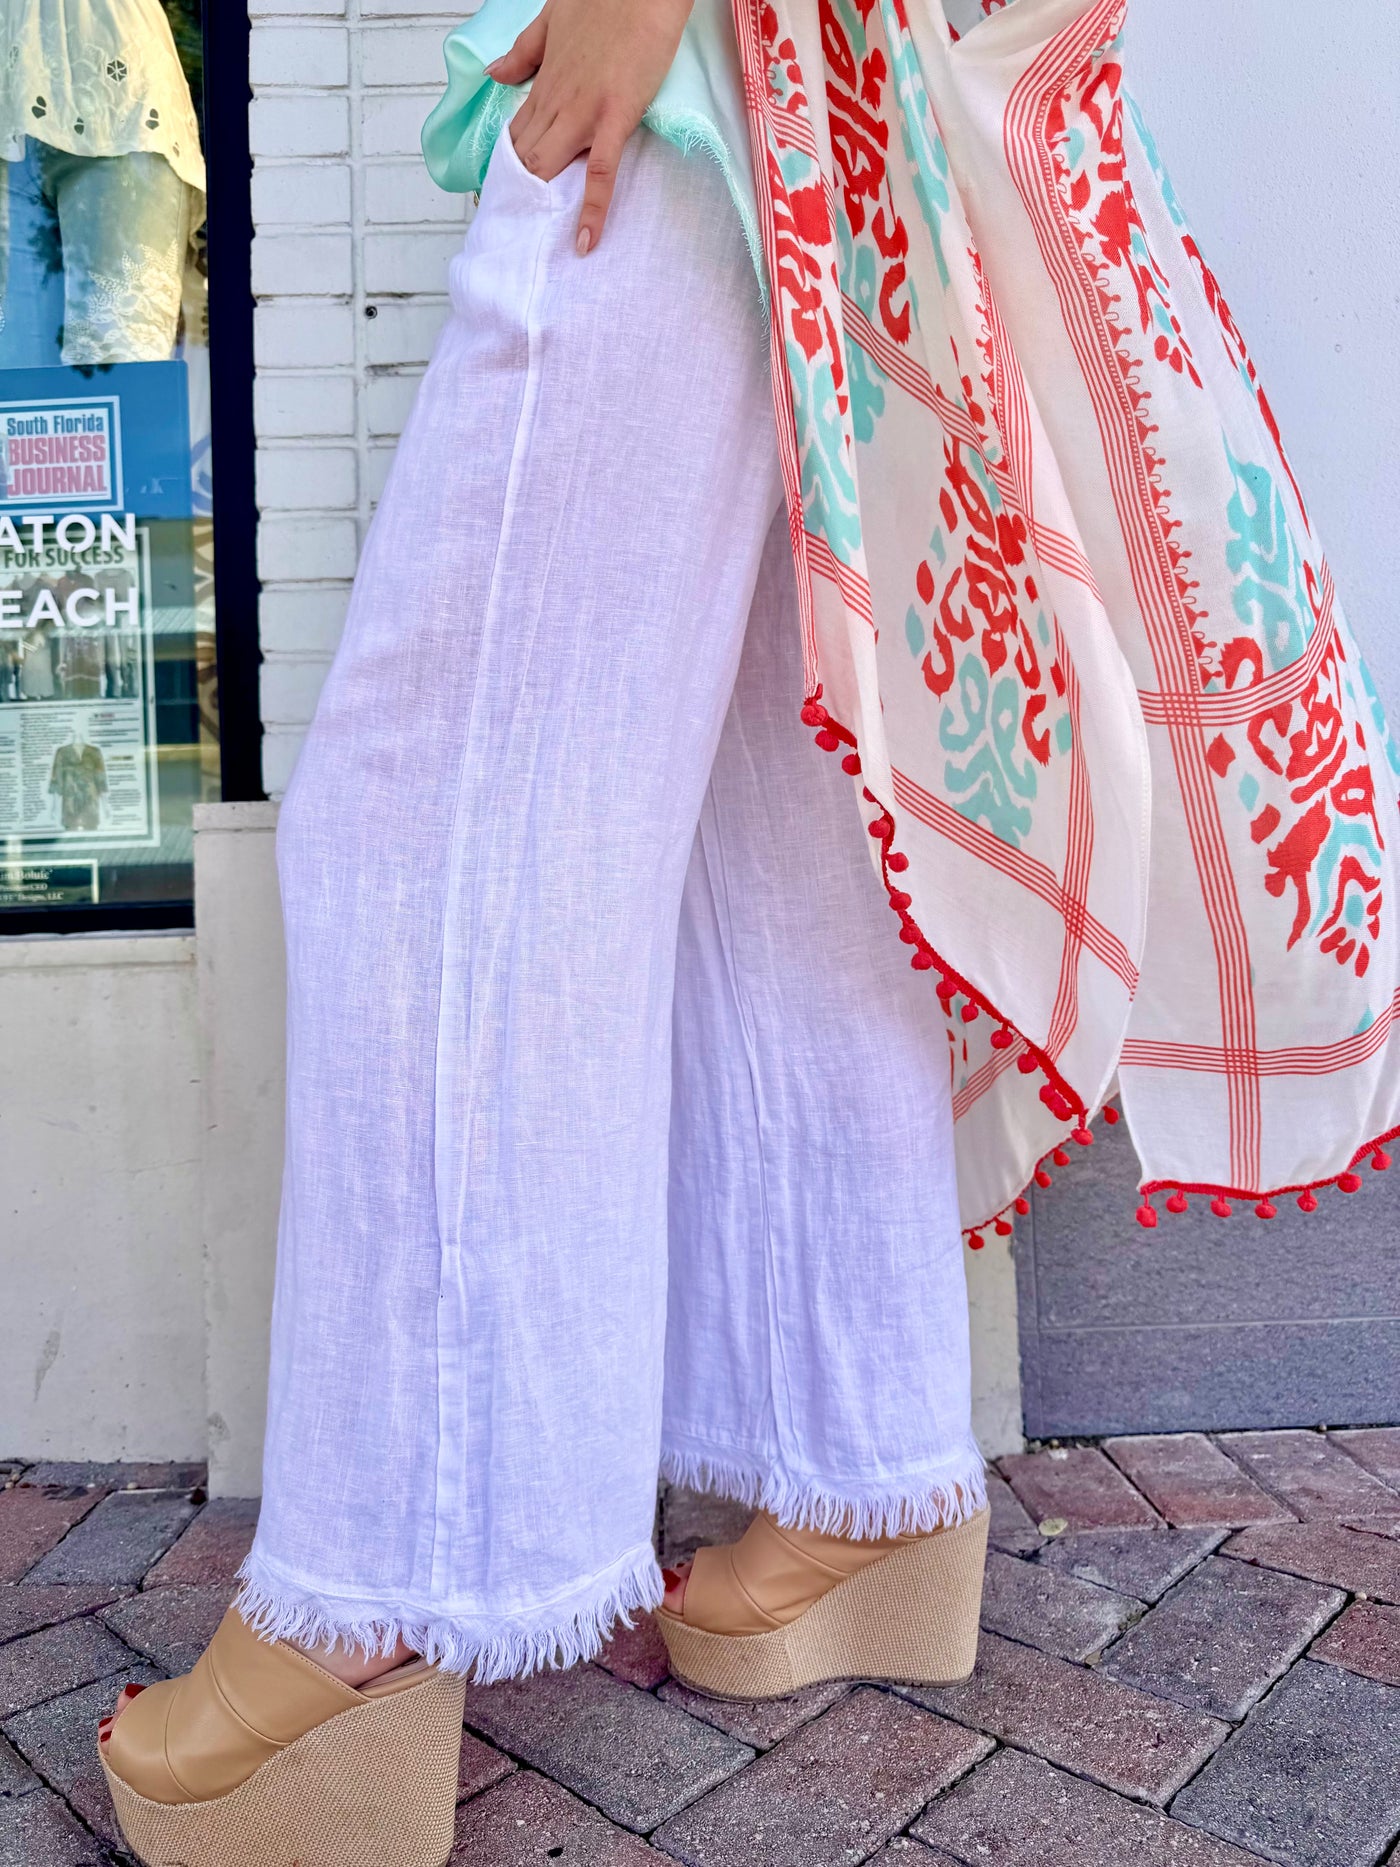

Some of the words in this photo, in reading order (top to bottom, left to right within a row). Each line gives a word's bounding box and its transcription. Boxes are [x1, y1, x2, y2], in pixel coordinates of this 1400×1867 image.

[7, 416, 48, 435] South
[53, 414, 104, 434] Florida
[8, 434, 107, 466] BUSINESS
[7, 465, 107, 496] JOURNAL
[0, 513, 136, 554] ATON
[0, 587, 138, 628] EACH
